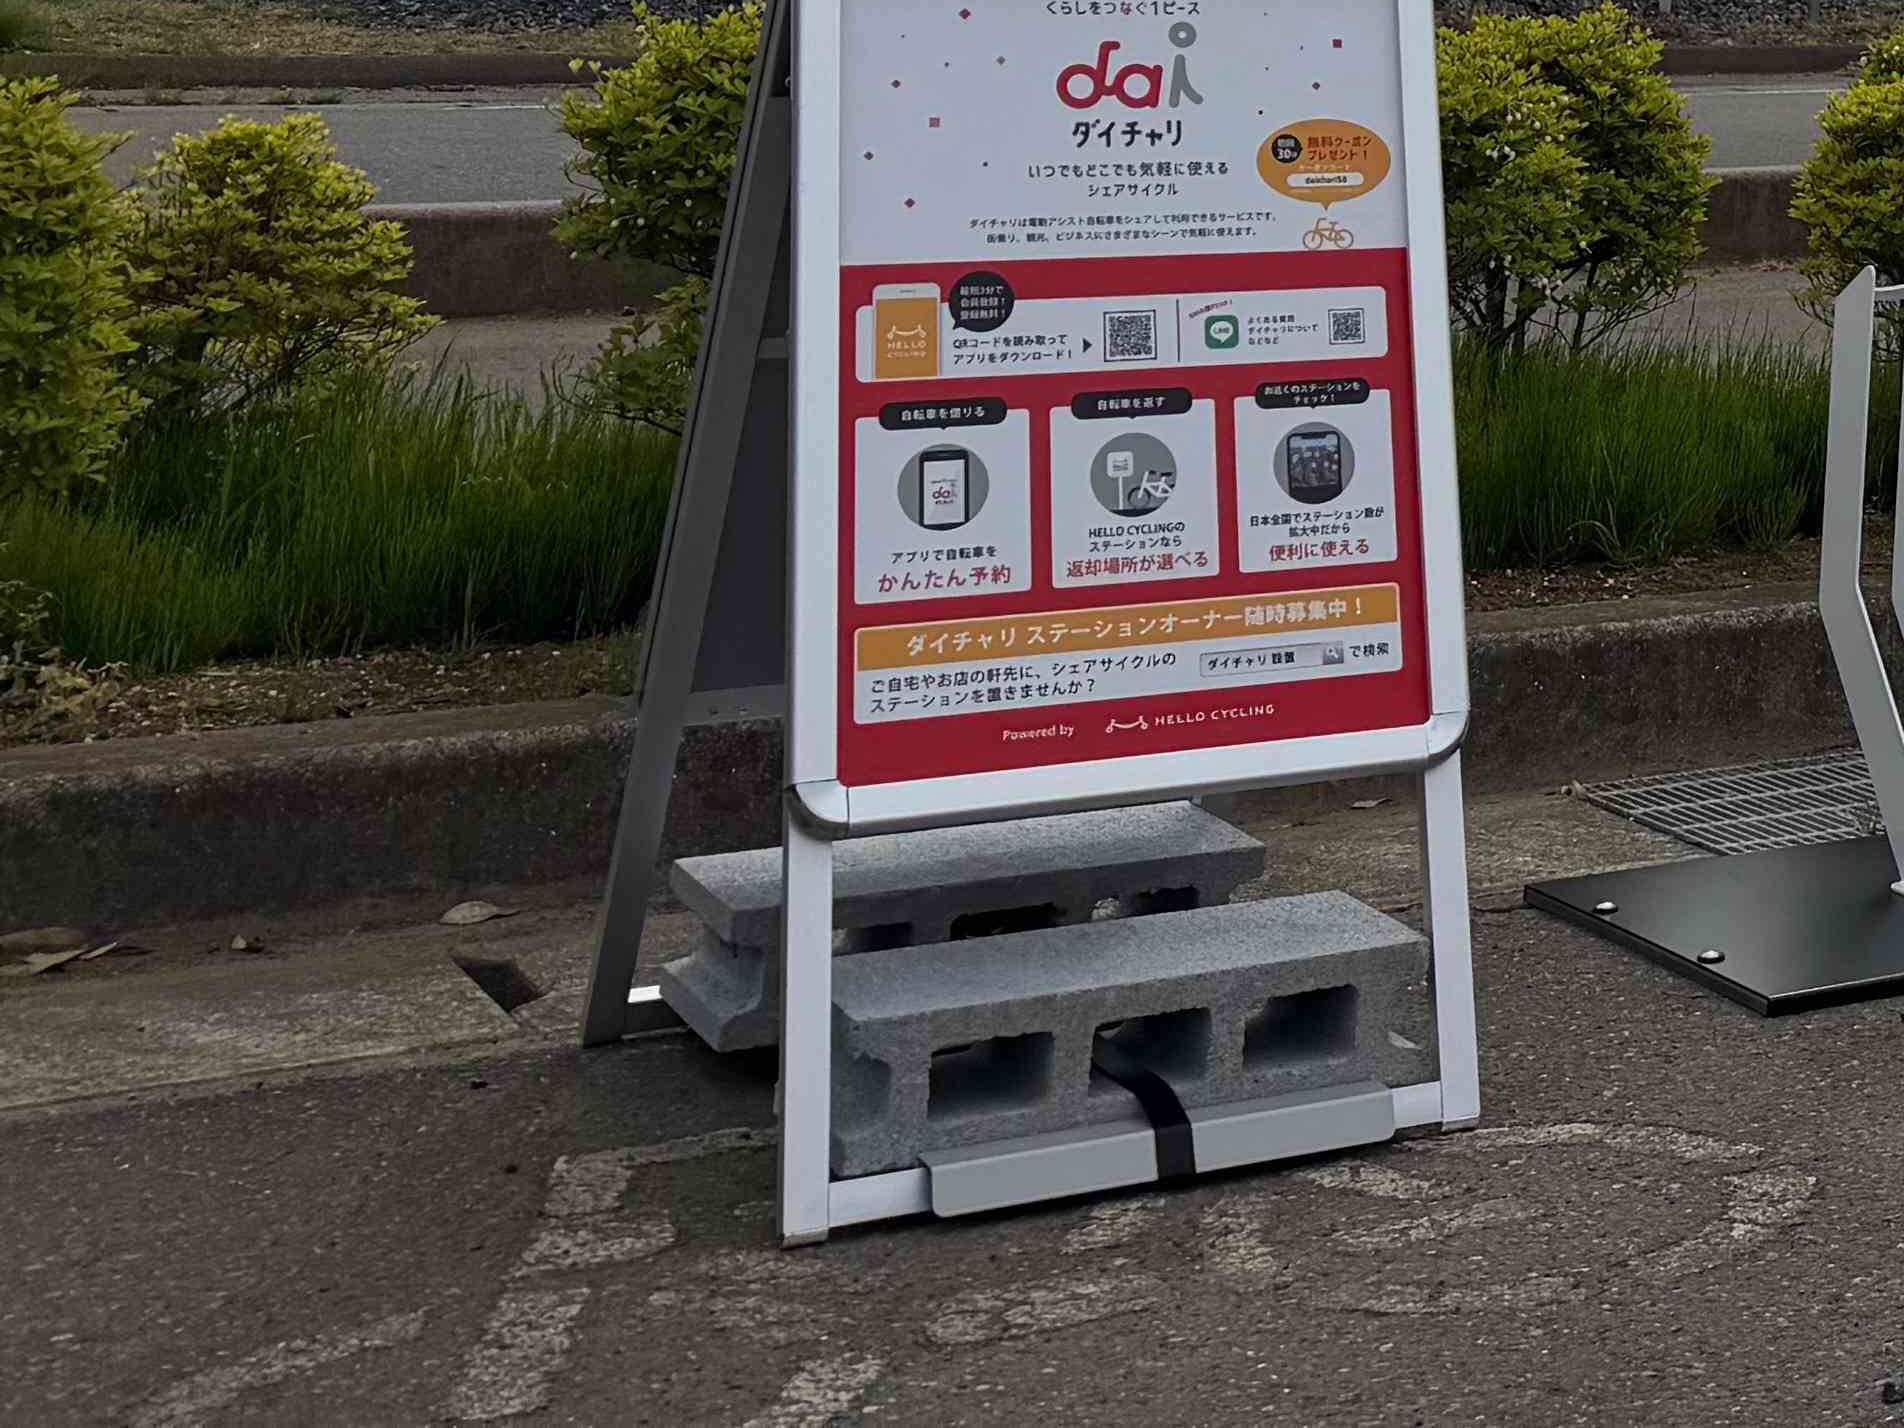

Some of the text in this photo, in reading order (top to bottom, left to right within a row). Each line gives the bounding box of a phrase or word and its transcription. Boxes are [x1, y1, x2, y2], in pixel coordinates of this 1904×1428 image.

[1072, 119, 1183, 148] ダイチャリ
[1028, 161, 1229, 179] いつでもどこでも気軽に使える
[1088, 182, 1179, 198] シェアサイクル
[952, 334, 1069, 349] QRコードを読み取って
[1097, 396, 1168, 411] 自転車を返す
[901, 406, 986, 422] 自転車を借りる
[1088, 524, 1125, 538] HELLO
[1288, 522, 1351, 538] 拡大中だから
[1089, 535, 1183, 553] ステーションなら
[1268, 538, 1370, 562] 便利に使える
[891, 545, 999, 564] アプリで自転車を
[1066, 551, 1209, 578] 返却場所が選べる
[877, 564, 1012, 593] かんたん予約
[907, 627, 1016, 657] ダイチャリ
[871, 651, 1176, 693] ご自宅やお店の軒先に、シェアサイクルの
[1154, 704, 1275, 726] HELLO CYCLING
[1002, 724, 1075, 741] Powered by
